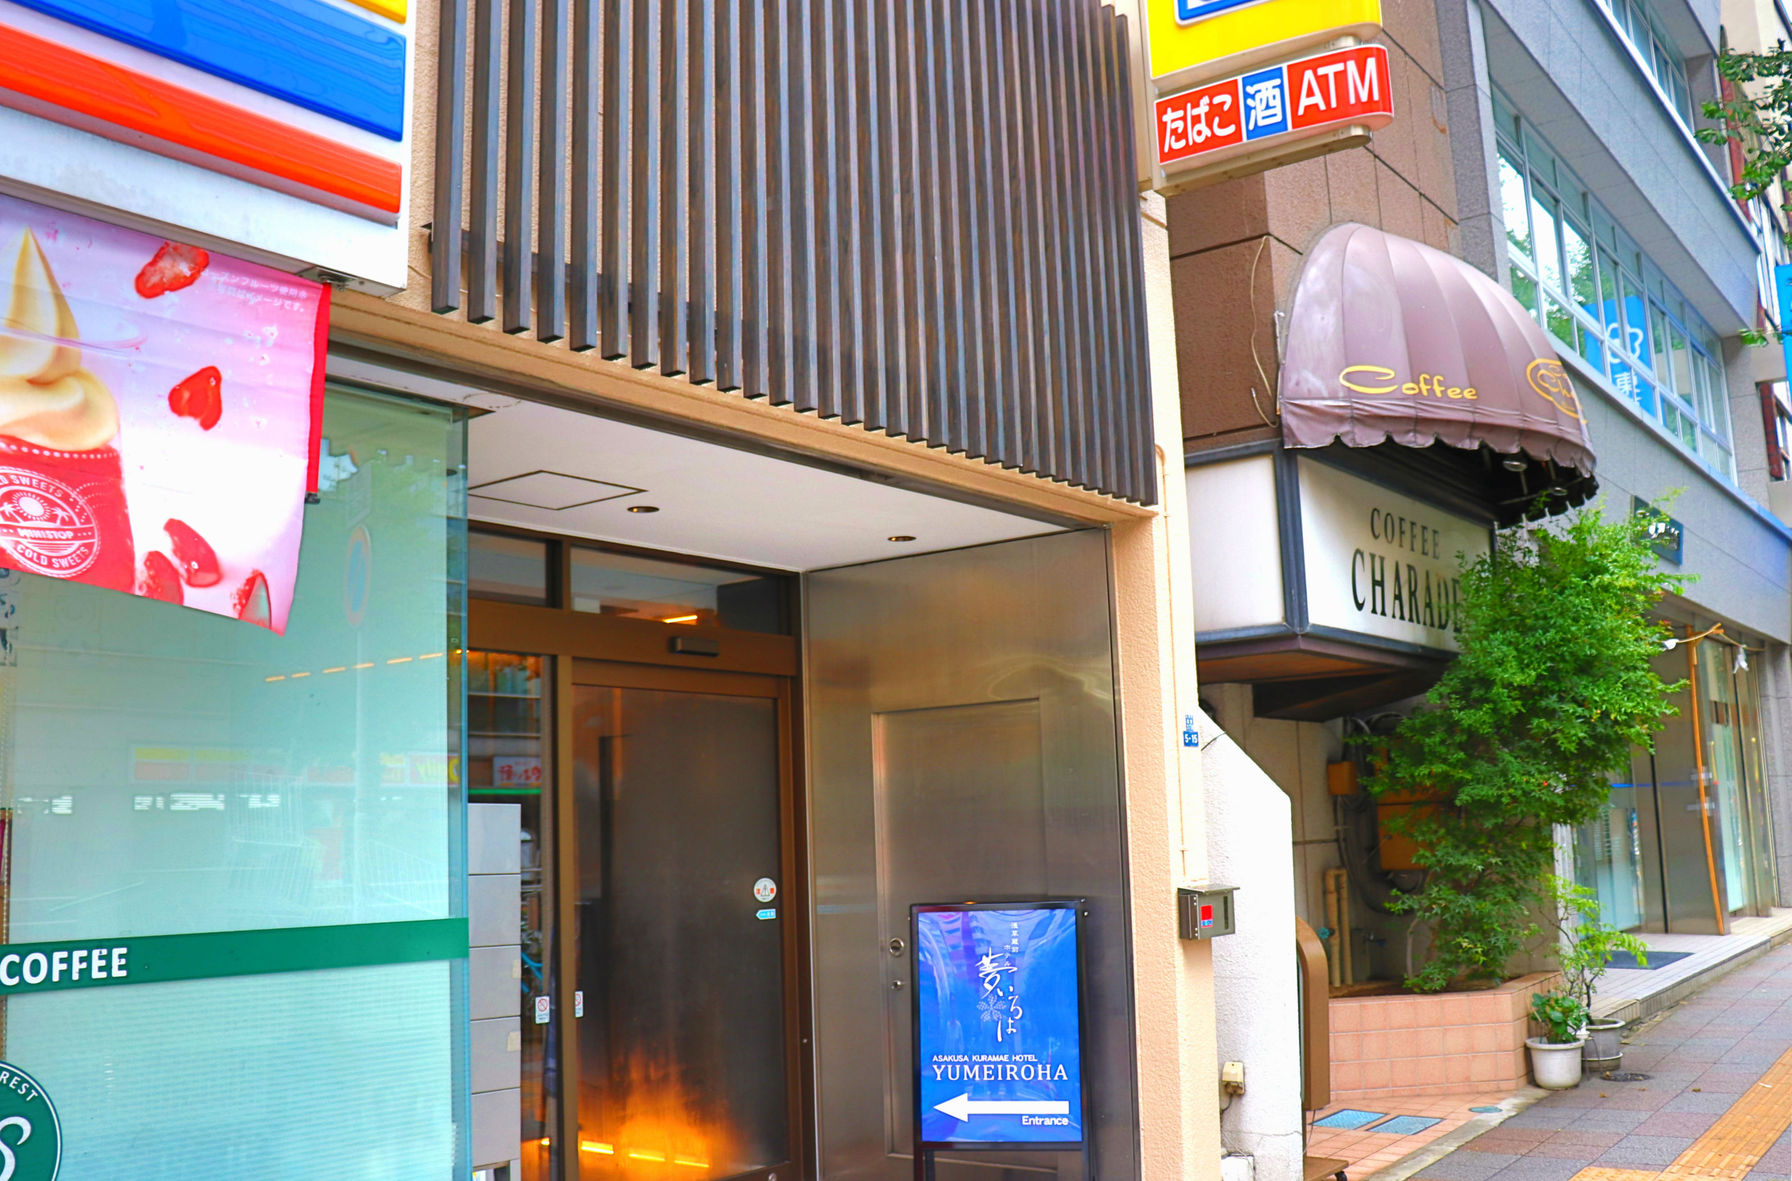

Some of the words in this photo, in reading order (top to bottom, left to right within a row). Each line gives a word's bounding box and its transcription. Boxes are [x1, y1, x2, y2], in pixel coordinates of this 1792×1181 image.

[1162, 94, 1236, 153] たばこ
[1245, 78, 1283, 131] 酒
[1297, 56, 1380, 116] ATM
[1339, 365, 1478, 399] Coffee
[10, 474, 64, 498] SWEETS
[17, 527, 74, 539] MINISTOP
[1370, 507, 1440, 560] COFFEE
[16, 543, 49, 566] COLD
[51, 546, 88, 568] SWEETS
[0, 947, 128, 987] COFFEE
[932, 1054, 969, 1062] ASAKUSA
[972, 1054, 1009, 1062] KURAMAE
[1012, 1054, 1038, 1062] HOTEL
[932, 1064, 1068, 1081] YUMEIROHA
[0, 1070, 38, 1101] REST
[1022, 1115, 1069, 1126] Entrance
